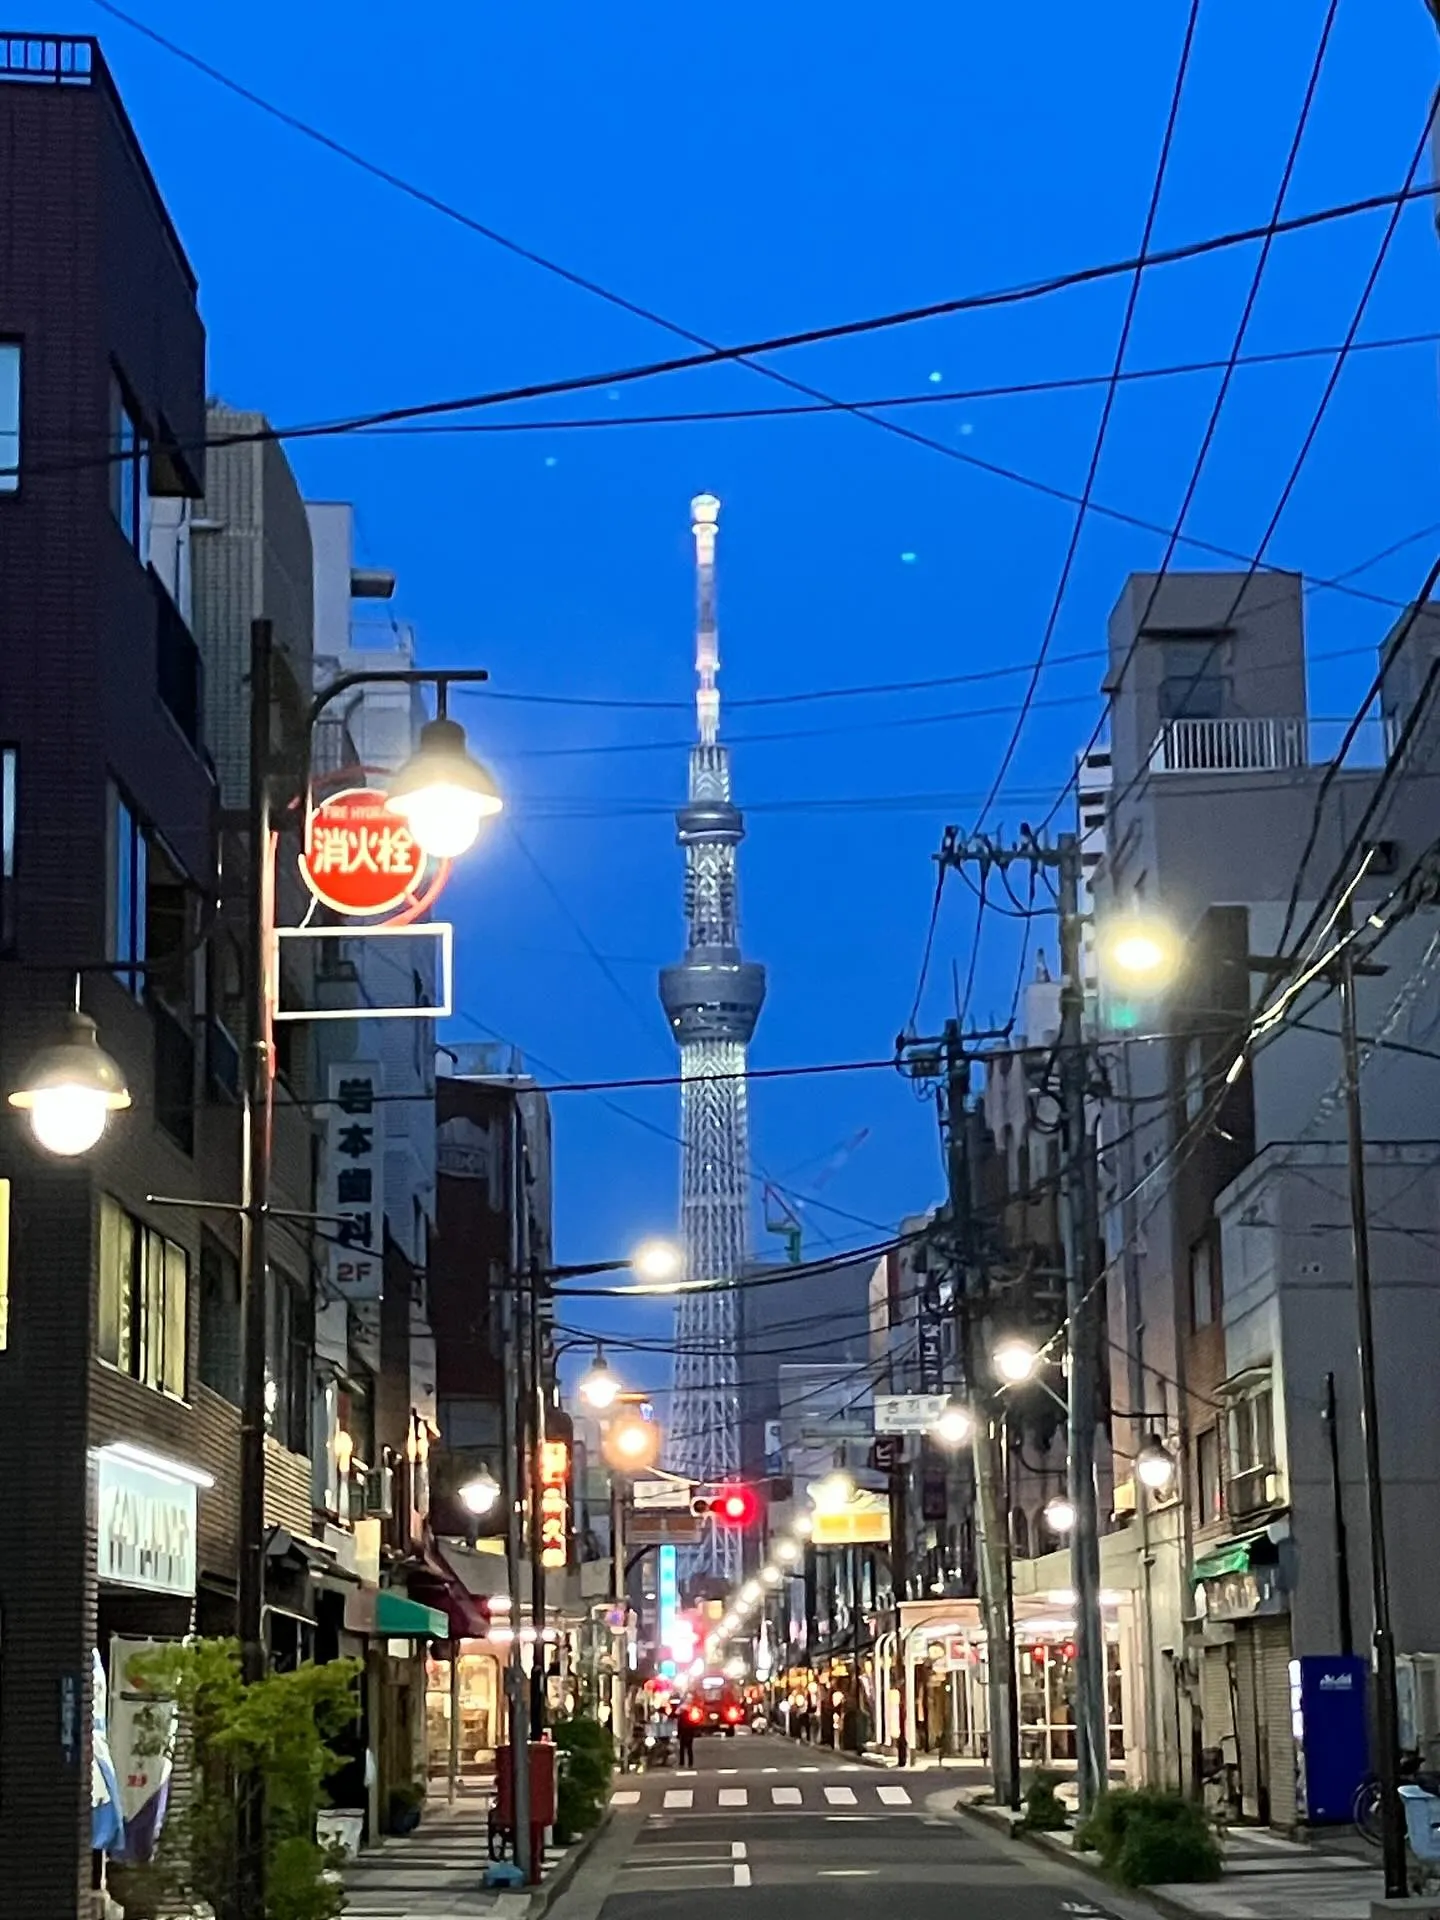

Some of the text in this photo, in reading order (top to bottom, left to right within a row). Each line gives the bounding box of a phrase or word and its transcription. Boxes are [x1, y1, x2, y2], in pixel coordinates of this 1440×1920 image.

[313, 826, 414, 874] 消火栓
[337, 1262, 372, 1282] 2F
